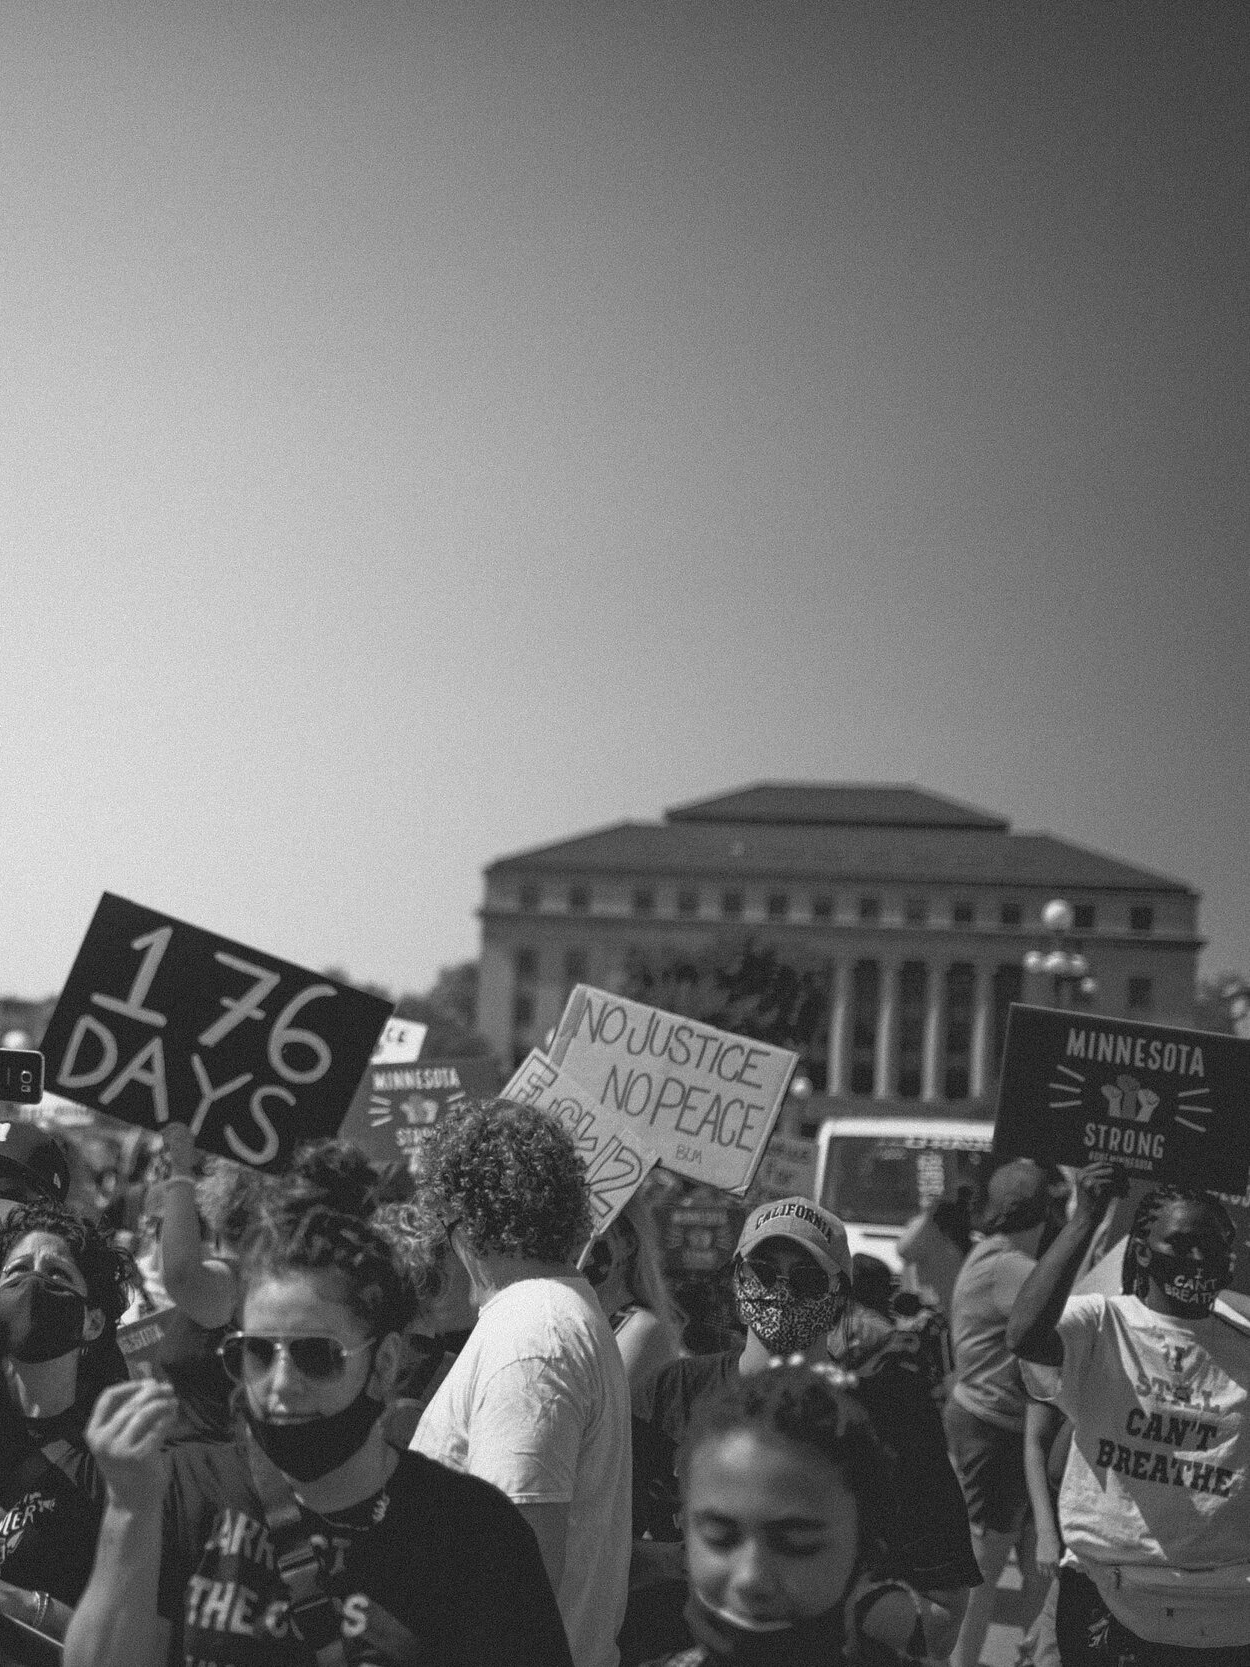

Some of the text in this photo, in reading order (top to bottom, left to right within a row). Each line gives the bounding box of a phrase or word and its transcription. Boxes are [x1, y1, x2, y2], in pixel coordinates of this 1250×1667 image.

[573, 998, 771, 1089] NO JUSTICE
[1066, 1027, 1205, 1077] MINNESOTA
[57, 1014, 297, 1165] DAYS
[372, 1067, 461, 1092] MINNESOTA
[600, 1064, 764, 1153] NO PEACE
[1083, 1122, 1165, 1159] STRONG
[755, 1203, 832, 1243] CALIFORNIA
[1126, 1408, 1217, 1452] CAN'T
[1096, 1438, 1236, 1498] BREATHE
[188, 1574, 258, 1636] THE
